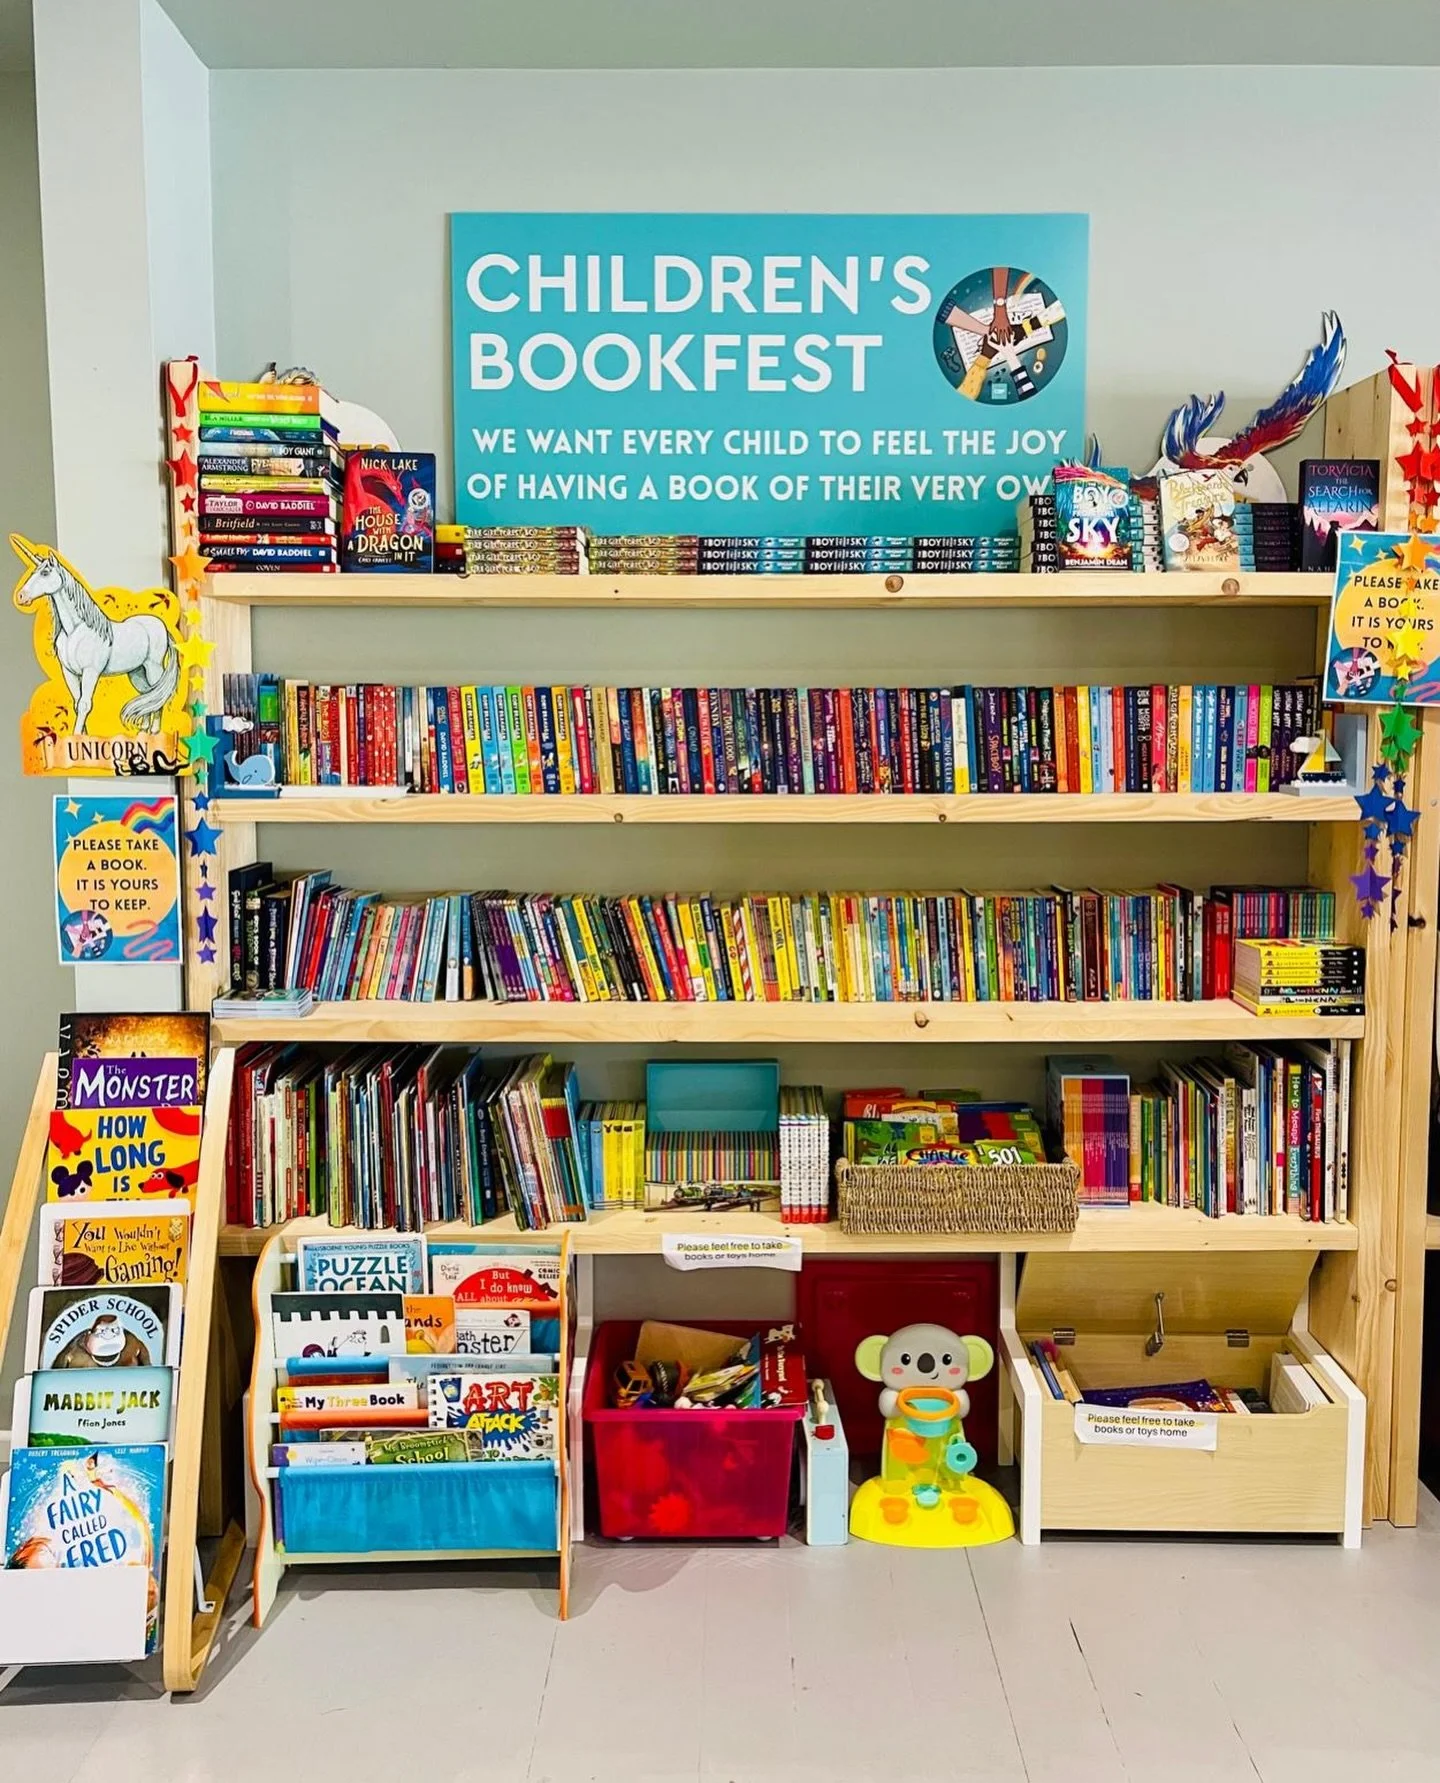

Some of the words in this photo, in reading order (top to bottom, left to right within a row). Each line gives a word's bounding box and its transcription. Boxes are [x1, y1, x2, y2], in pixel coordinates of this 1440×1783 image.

[466, 253, 931, 314] CHILDREN'S
[469, 333, 883, 392] BOOKFEST
[472, 430, 516, 456] WE
[527, 430, 612, 456] WANT
[624, 430, 712, 456] EVERY
[724, 430, 808, 456] CHILD
[820, 430, 861, 456] TO
[873, 430, 933, 456] FEEL
[943, 430, 995, 456] THE
[1006, 430, 1067, 456] JOY
[202, 464, 248, 472] ARMSTRONG
[361, 458, 387, 470] NICK
[392, 459, 418, 470] LAKE
[467, 475, 507, 500] OF
[518, 475, 627, 500] HAVING
[639, 475, 659, 500] A
[668, 475, 758, 500] BOOK
[769, 475, 810, 500] OF
[820, 475, 900, 500] THEIR
[912, 475, 985, 500] VERY
[997, 475, 1053, 499] OW
[1073, 485, 1109, 504] BOY
[1309, 485, 1357, 499] SEARCH
[256, 501, 278, 510] DAVID
[280, 502, 315, 510] BADDIEL
[215, 518, 255, 529] Britfield
[356, 513, 401, 531] HOUSE
[1067, 517, 1120, 543] SKY
[373, 527, 391, 535] WITH
[348, 540, 353, 550] A
[355, 534, 424, 554] DRAGON
[708, 538, 727, 546] BOY
[741, 538, 760, 546] SKY
[922, 538, 941, 546] BOY
[405, 552, 415, 561] IT
[814, 550, 834, 558] BOY
[849, 550, 867, 558] SKY
[707, 562, 726, 571] BOY
[741, 562, 759, 570] SKY
[921, 562, 940, 570] BOY
[1354, 576, 1402, 589] PLEASE
[1408, 578, 1439, 590] AKE
[1364, 598, 1373, 607] A
[1352, 616, 1363, 627] IT
[1369, 617, 1380, 628] IS
[1362, 637, 1381, 648] TO
[68, 742, 148, 760] UNICORN
[73, 839, 121, 852] PLEASE
[127, 839, 159, 851] TAKE
[87, 859, 96, 871] A
[101, 859, 147, 871] BOOK.
[76, 878, 88, 891] IT
[94, 878, 105, 891] IS
[112, 878, 158, 891] YOURS
[89, 898, 109, 911] TO
[114, 898, 150, 911] KEEP.
[106, 1065, 126, 1075] The
[75, 1065, 194, 1107] MONSTER
[1292, 1076, 1300, 1095] How
[1292, 1099, 1300, 1108] to
[98, 1115, 147, 1140] HOW
[95, 1140, 166, 1175] LONG
[989, 1146, 1022, 1164] 501
[1289, 1147, 1299, 1190] Everything
[113, 1175, 131, 1194] IS
[72, 1221, 106, 1248] You
[114, 1224, 160, 1241] Wouldn't
[84, 1243, 105, 1253] Want
[119, 1242, 136, 1253] Live
[677, 1243, 709, 1252] Please
[731, 1242, 749, 1250] free
[751, 1242, 760, 1250] to
[105, 1247, 182, 1283] Gaming!
[318, 1256, 408, 1276] PUZZLE
[492, 1271, 510, 1280] But
[319, 1276, 406, 1294] OCEAN
[480, 1279, 485, 1289] I
[490, 1283, 503, 1293] do
[507, 1283, 532, 1293] know
[456, 1292, 477, 1301] ALL
[480, 1293, 508, 1303] about
[48, 1300, 99, 1344] SPIDER
[106, 1298, 157, 1339] SCHOOL
[43, 1391, 114, 1412] MABBIT
[117, 1389, 161, 1414] JACK
[305, 1397, 325, 1410] My
[327, 1396, 368, 1407] Three
[370, 1394, 405, 1405] Book
[463, 1381, 534, 1415] ART
[465, 1412, 527, 1433] ATTACK
[1088, 1414, 1120, 1424] Please
[1122, 1415, 1141, 1425] feel
[1142, 1416, 1160, 1425] free
[1163, 1418, 1173, 1426] to
[1174, 1418, 1195, 1427] take
[1094, 1425, 1124, 1434] books
[1138, 1427, 1158, 1438] toys
[1160, 1428, 1187, 1437] home
[396, 1447, 449, 1464] School
[63, 1473, 77, 1496] A
[47, 1489, 101, 1529] FAIRY
[62, 1515, 107, 1544] CALLED
[66, 1528, 127, 1568] FRED
